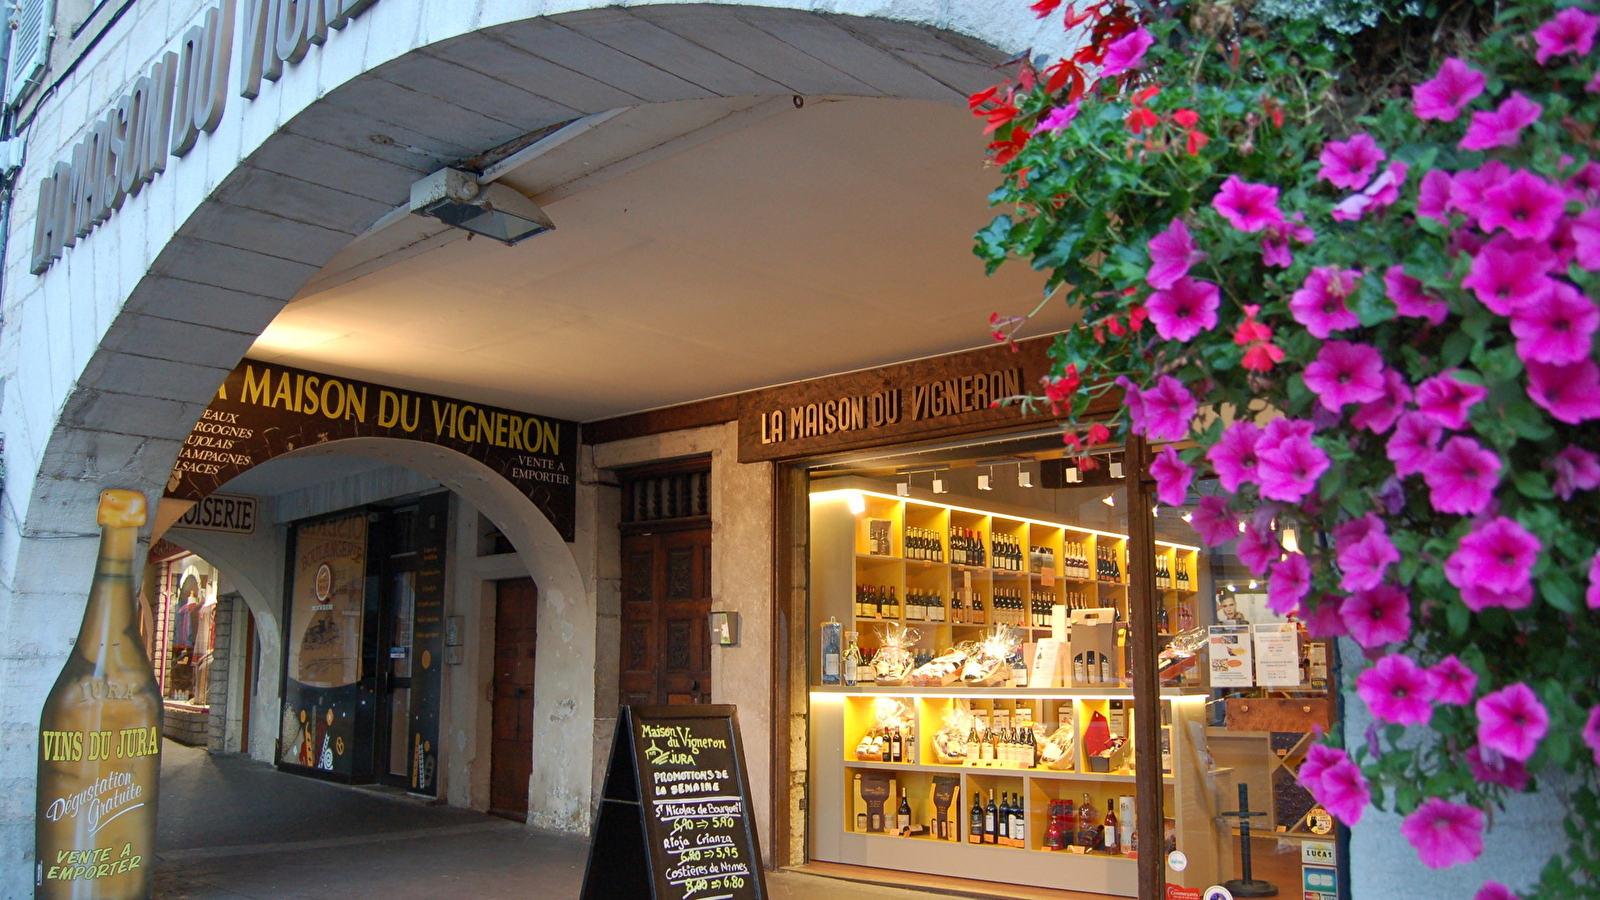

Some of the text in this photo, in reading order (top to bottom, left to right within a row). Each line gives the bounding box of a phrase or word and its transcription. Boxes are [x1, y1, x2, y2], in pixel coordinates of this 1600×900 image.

[63, 51, 179, 248] MAISON
[171, 0, 235, 157] DU
[241, 365, 560, 456] MAISON DU VIGNERON
[761, 367, 1021, 445] LA MAISON DU VIGNERON
[184, 435, 235, 450] UJOLAIS
[518, 455, 565, 472] VENTE A
[512, 467, 569, 485] EMPORTER
[79, 682, 136, 702] JURA
[641, 725, 677, 738] Maison
[667, 726, 726, 754] du Vigneron
[43, 726, 159, 762] VINS DU JURA
[653, 769, 729, 784] PROMOTIONS DE
[46, 771, 131, 822] Dégustation
[655, 782, 720, 796] LA SEMAINE
[88, 784, 142, 832] Gratuite
[666, 803, 696, 816] Nicolas
[698, 804, 707, 815] de
[663, 833, 732, 850] Rioja Crianza
[57, 843, 131, 864] VENTE A
[716, 846, 739, 859] 5,95
[1306, 850, 1332, 858] LUCAS
[47, 855, 142, 880] EMPORTER
[709, 863, 719, 874] de
[723, 875, 744, 889] 6,80
